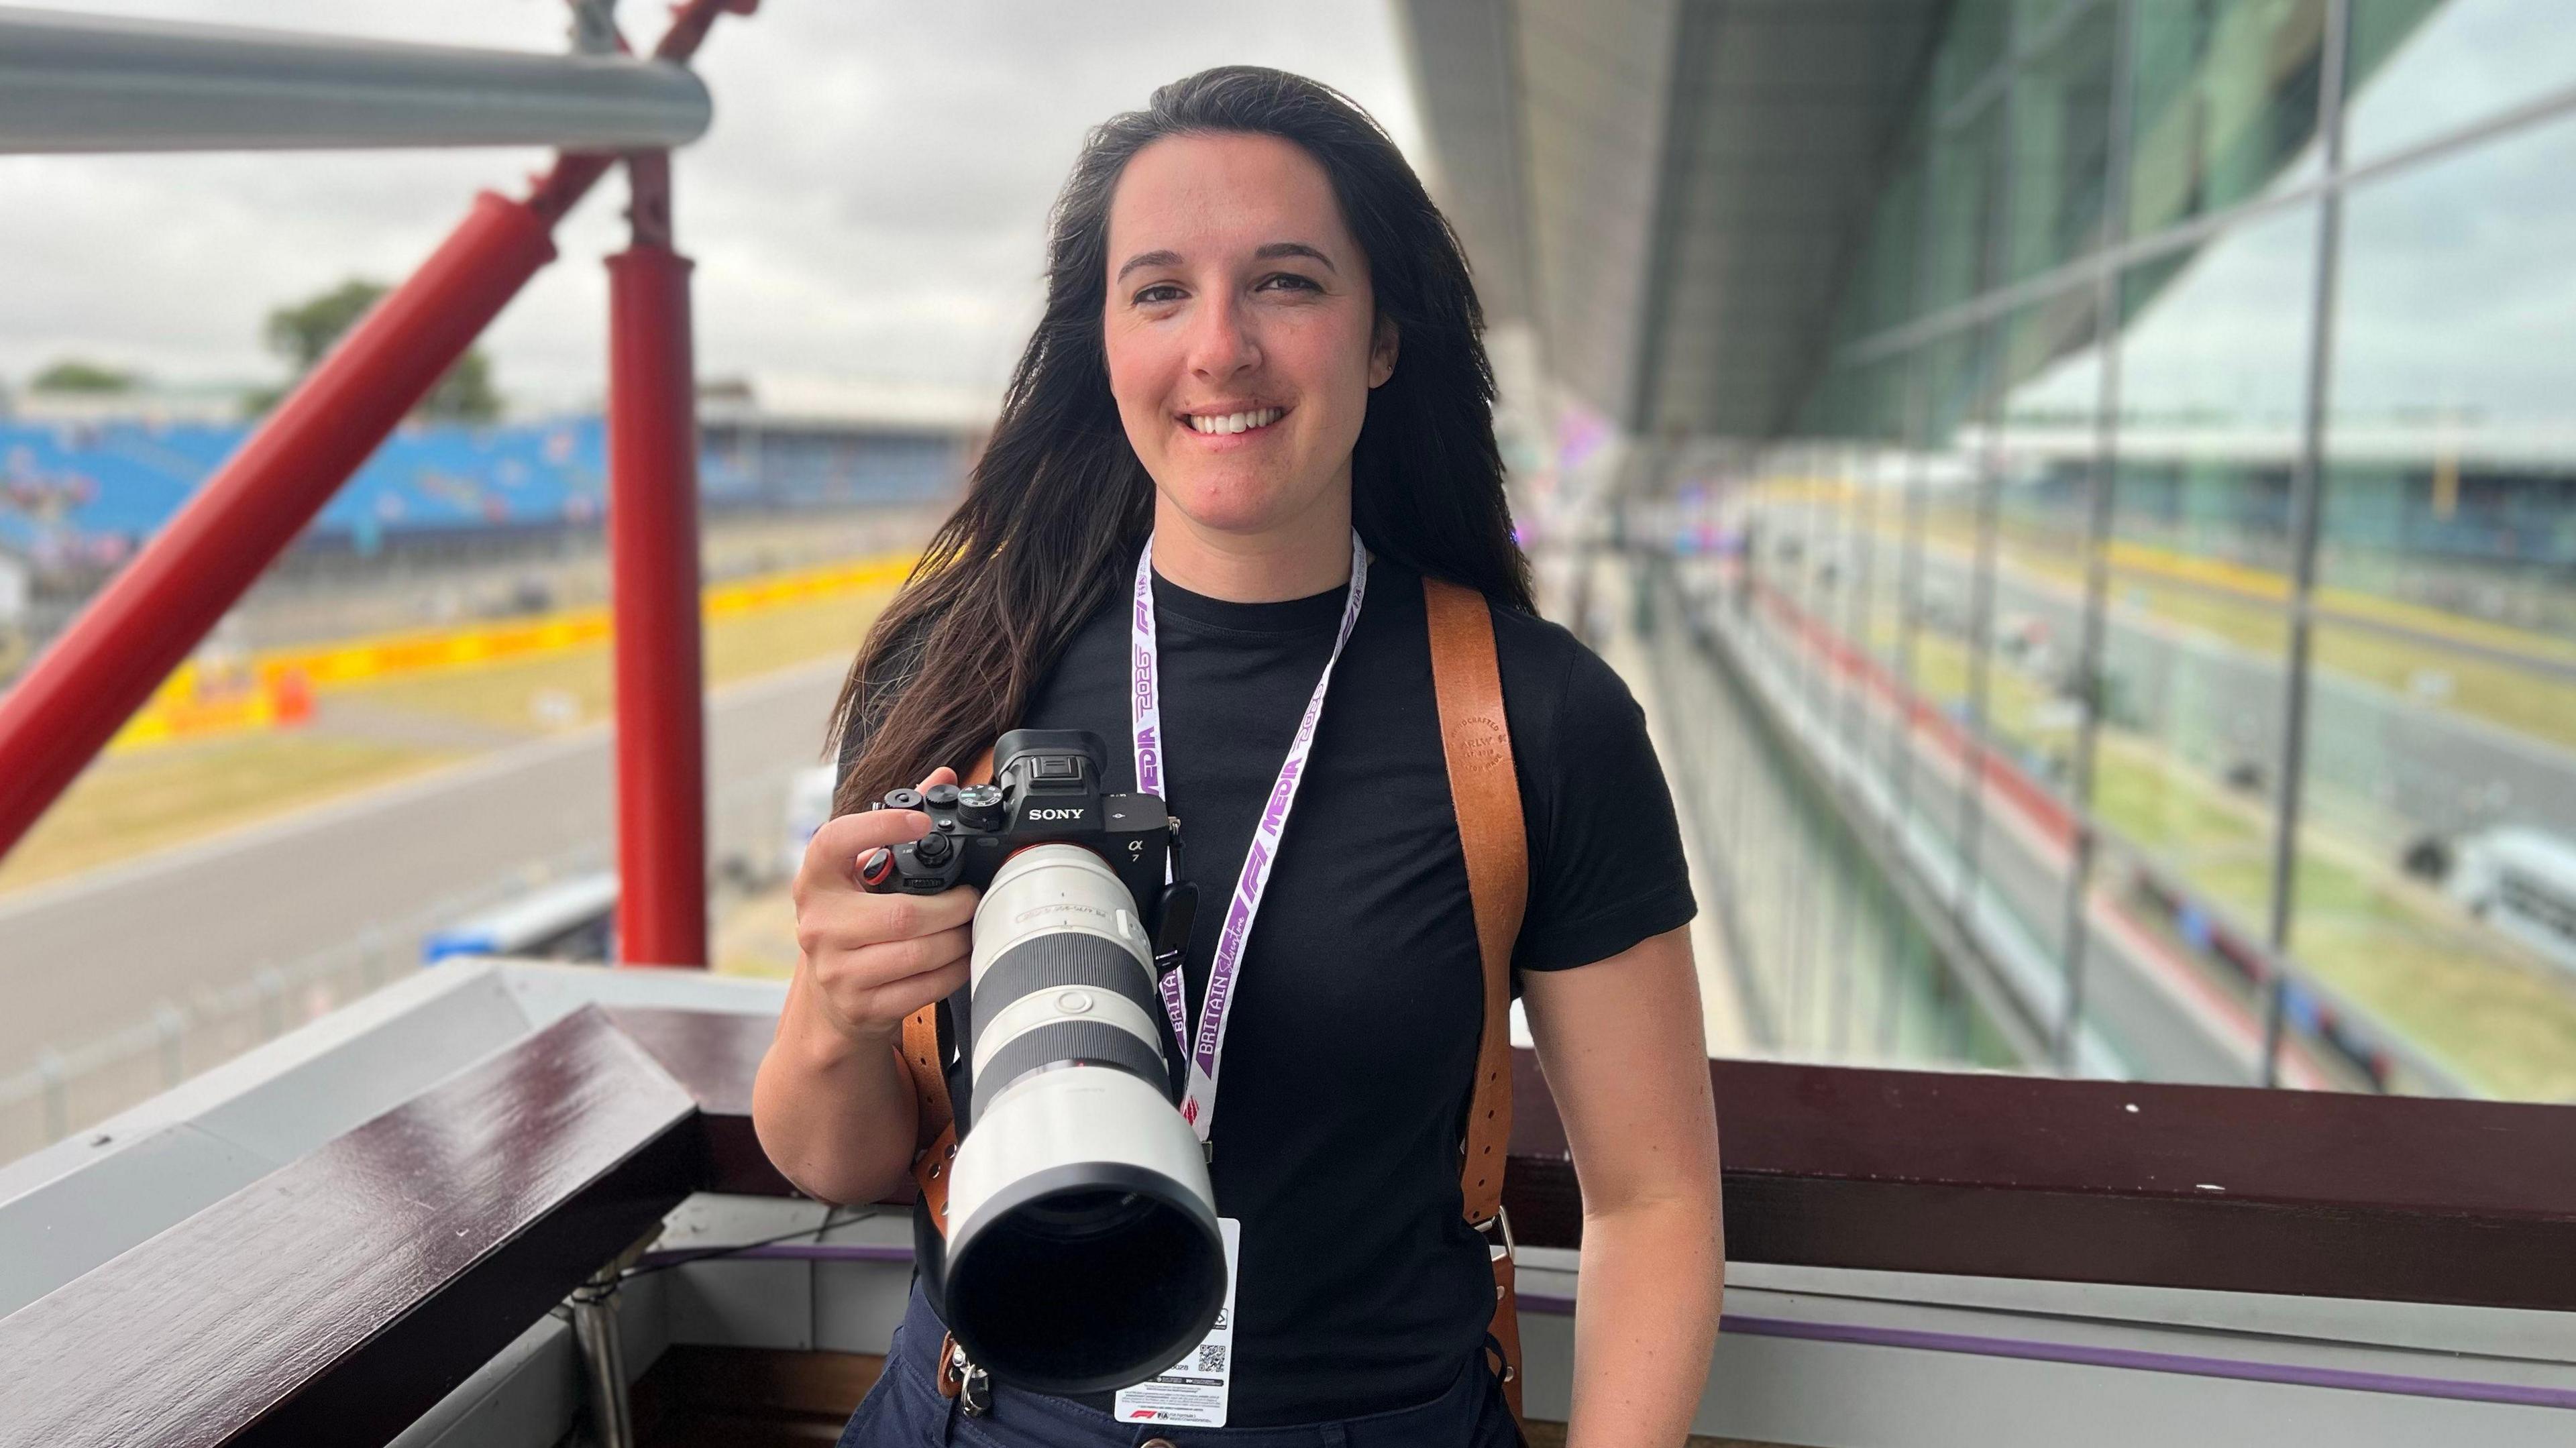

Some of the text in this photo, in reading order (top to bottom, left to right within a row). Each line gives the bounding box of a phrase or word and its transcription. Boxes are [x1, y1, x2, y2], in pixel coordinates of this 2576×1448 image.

[1136, 599, 1149, 636] F1
[1135, 644, 1153, 723] 2026
[1029, 809, 1084, 820] SONY
[1132, 854, 1140, 862] 7
[1199, 974, 1228, 1054] BRITAIN
[1242, 838, 1269, 904] F1
[1262, 757, 1303, 837] MEDIA
[1291, 683, 1324, 754] 2026
[1163, 969, 1184, 1033] BRITA
